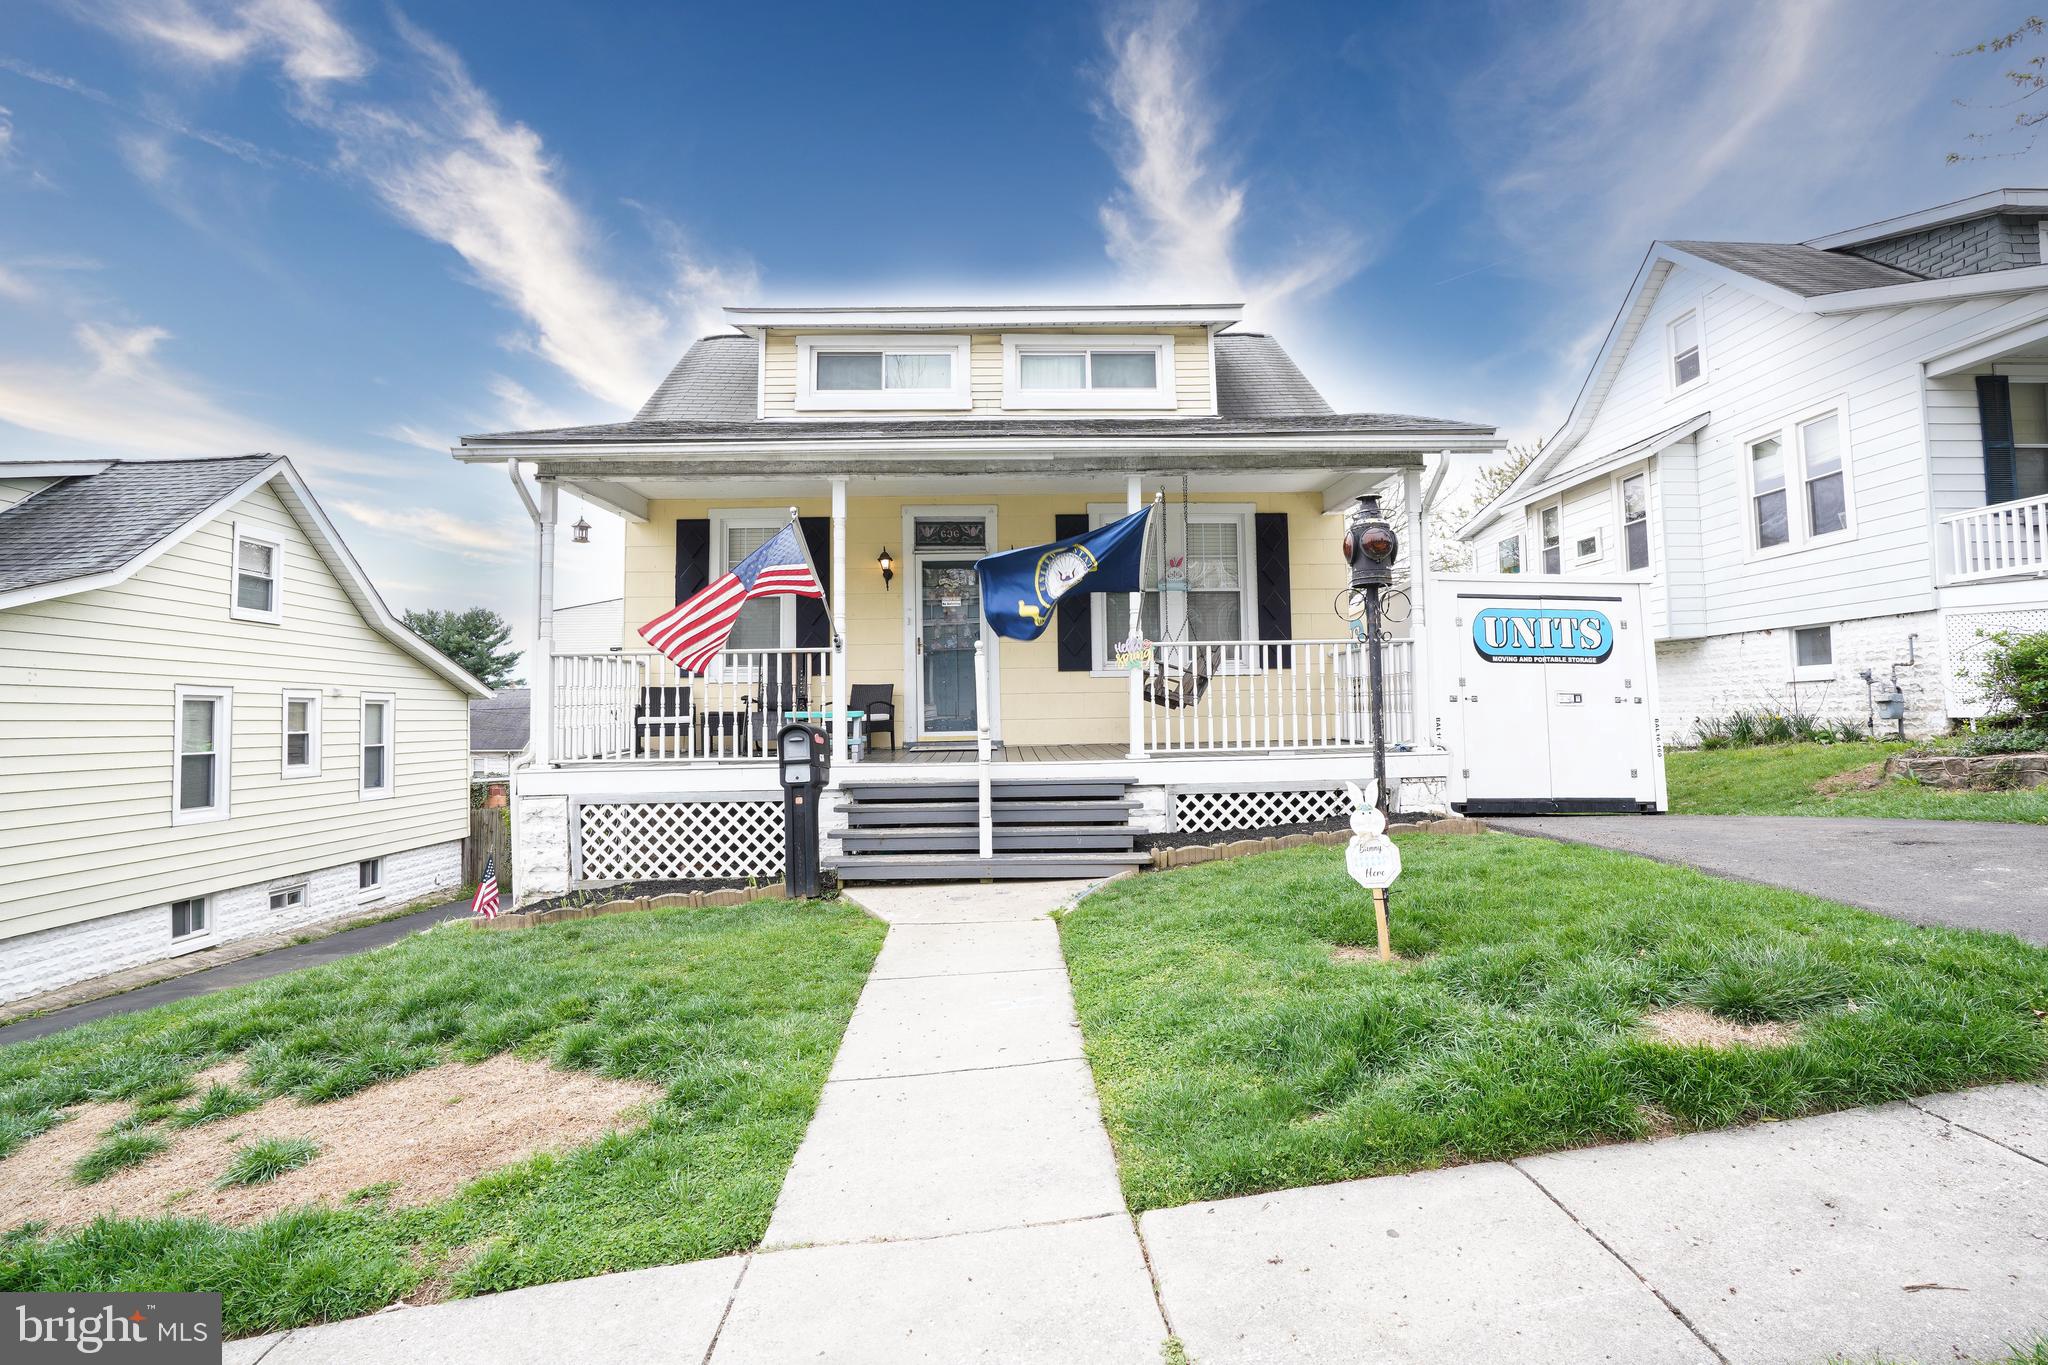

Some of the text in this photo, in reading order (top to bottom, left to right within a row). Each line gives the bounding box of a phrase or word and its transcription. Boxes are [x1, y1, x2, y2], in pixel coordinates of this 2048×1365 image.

[1482, 616, 1602, 650] UNITS
[1359, 843, 1382, 854] Bunny
[1365, 868, 1385, 879] Here
